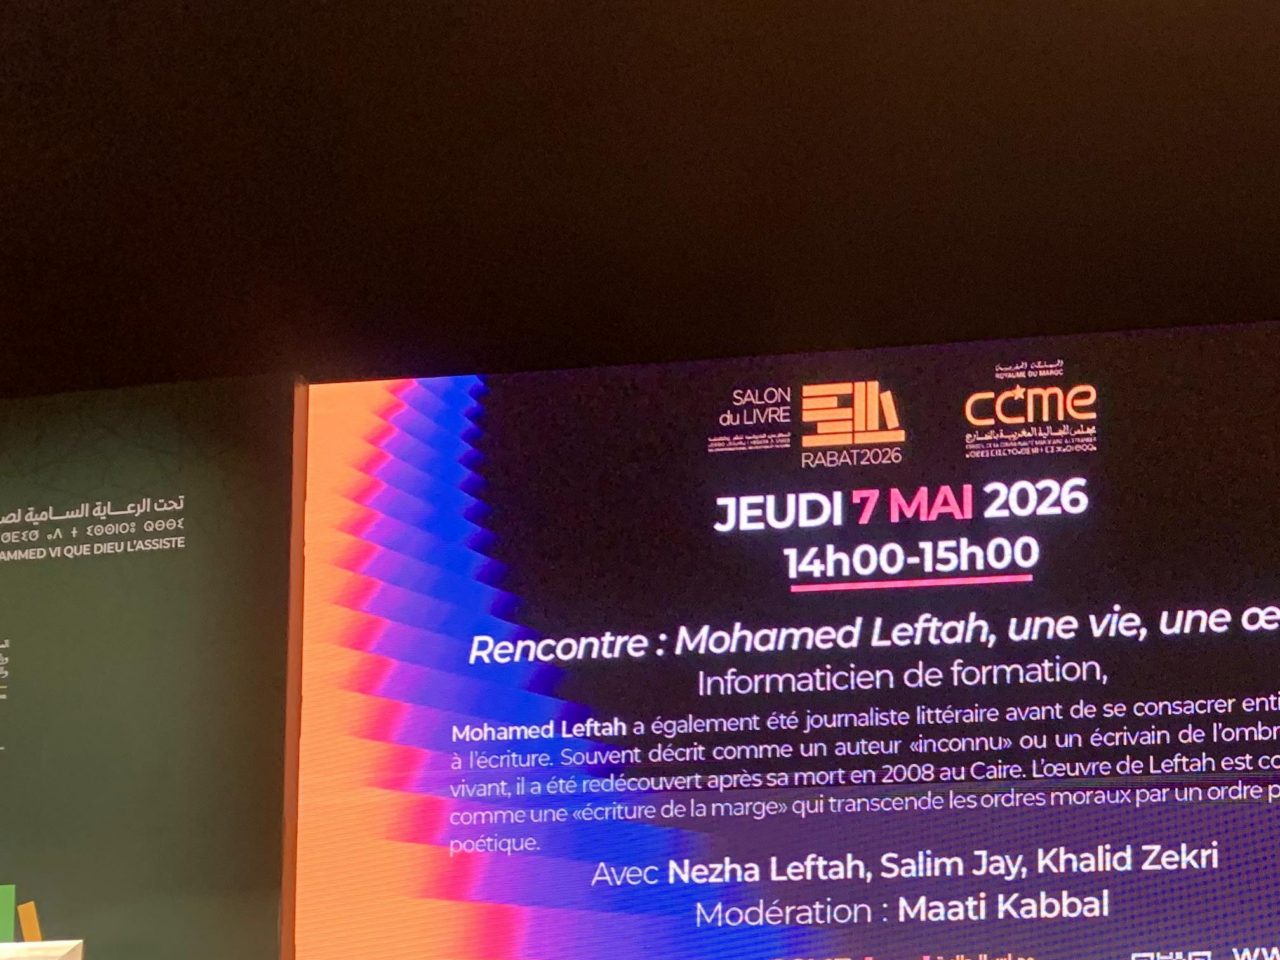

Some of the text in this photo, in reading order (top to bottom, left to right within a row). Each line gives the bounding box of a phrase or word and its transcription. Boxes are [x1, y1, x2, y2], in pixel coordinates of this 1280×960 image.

[719, 406, 791, 426] du LIVRE
[732, 387, 791, 405] SALON
[801, 447, 902, 468] RABAT2026
[25, 495, 185, 525] تحت الرعاية السامية
[713, 477, 1089, 532] JEUDI 7 MAI 2026
[0, 536, 185, 561] AMMED VI QUE DIEU L'ASSISTE
[784, 535, 1040, 579] 14h00-15h00
[469, 633, 650, 665] Rencontre
[674, 616, 864, 655] Mohamed
[871, 611, 997, 648] Leftah,
[1007, 614, 1079, 641] une
[1089, 604, 1149, 642] vie,
[1159, 606, 1232, 634] une
[699, 655, 1109, 697] Informaticien de formation,
[452, 719, 555, 742] Mohamed
[561, 716, 627, 738] Leftah
[633, 721, 645, 735] a
[651, 715, 760, 738] également
[767, 711, 799, 731] été
[803, 707, 909, 733] journaliste
[916, 703, 999, 725] littéraire
[1006, 702, 1063, 721] avant
[1070, 699, 1097, 719] de
[1103, 702, 1126, 718] se
[1133, 697, 1236, 718] consacrer
[451, 752, 462, 770] à
[561, 745, 641, 767] Souvent
[649, 741, 706, 763] décrit
[713, 743, 793, 760] comme
[801, 741, 827, 757] un
[835, 738, 902, 756] auteur
[910, 733, 1013, 754] «inconnu»
[1020, 733, 1047, 749] ou
[1055, 732, 1083, 748] un
[1090, 725, 1171, 747] écrivain
[1178, 723, 1205, 743] de
[450, 777, 512, 799] vivant,
[516, 776, 525, 796] il
[530, 780, 541, 794] a
[546, 774, 577, 794] été
[582, 771, 702, 794] redécouvert
[707, 768, 762, 792] après
[767, 771, 790, 787] sa
[794, 767, 845, 786] mort
[851, 768, 876, 783] en
[882, 763, 935, 784] 2008
[940, 766, 965, 781] au
[970, 761, 1027, 781] Caire.
[1032, 756, 1111, 779] L'œuvre
[1116, 755, 1143, 775] de
[1149, 751, 1216, 774] Leftah
[1221, 752, 1253, 772] est
[450, 808, 526, 825] comme
[530, 806, 567, 823] une
[572, 801, 656, 822] «écriture
[661, 799, 687, 819] de
[691, 799, 707, 818] la
[711, 801, 788, 823] marge»
[792, 795, 825, 817] qui
[829, 790, 943, 813] transcende
[949, 790, 977, 810] les
[980, 787, 1046, 808] ordres
[1051, 788, 1131, 806] moraux
[1136, 785, 1170, 808] par
[1175, 785, 1202, 801] un
[1207, 780, 1263, 802] ordre
[450, 834, 541, 857] poétique.
[591, 841, 1219, 887] Avec Nezha Leftah, Salim Jay, Khalid Zekri
[696, 889, 1110, 927] Modération Maati Kabbal
